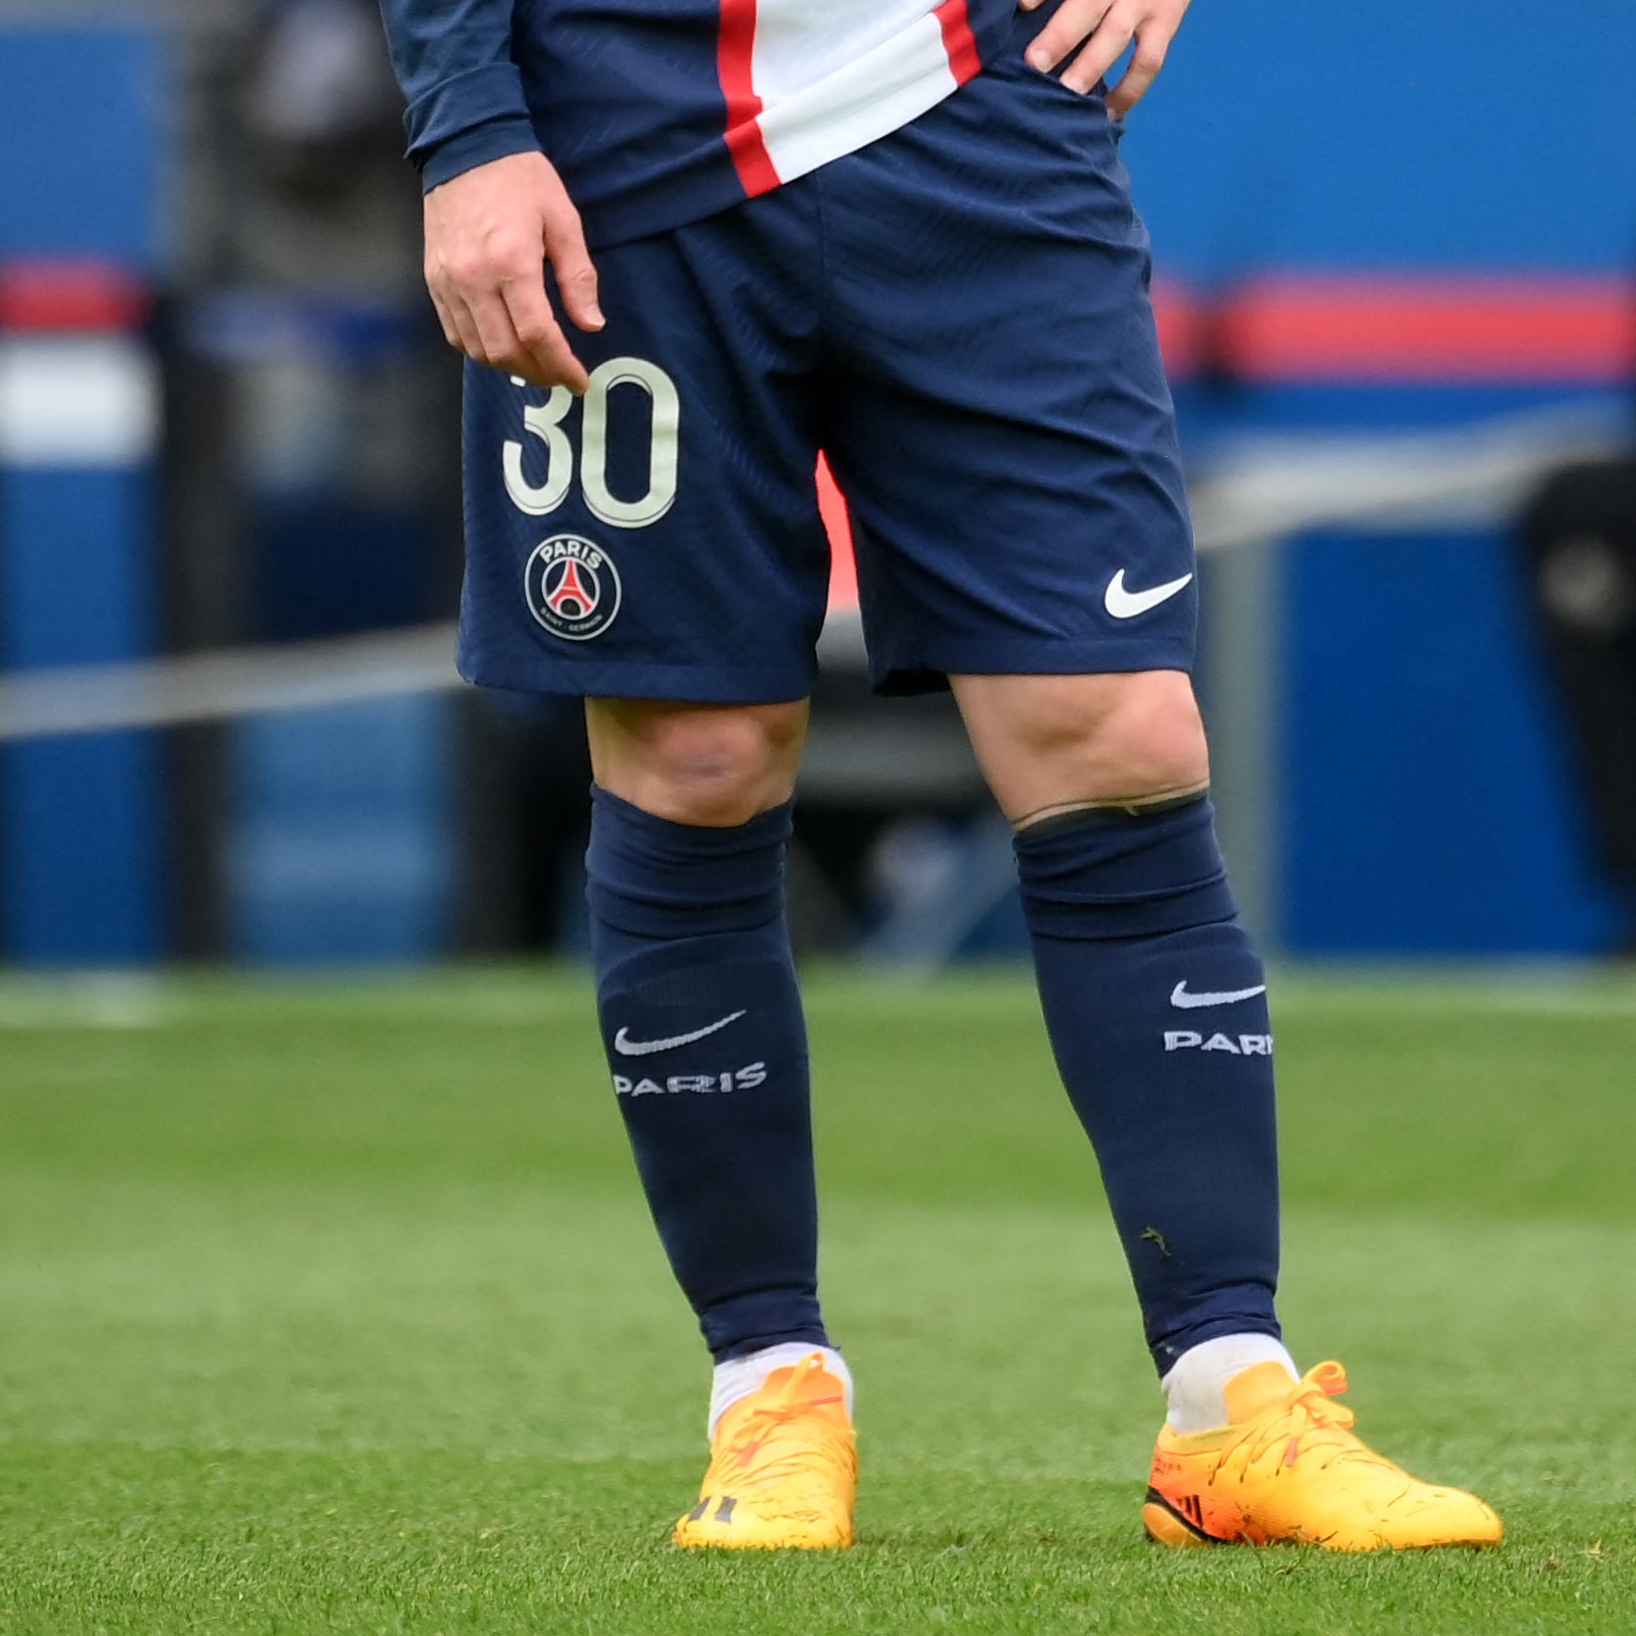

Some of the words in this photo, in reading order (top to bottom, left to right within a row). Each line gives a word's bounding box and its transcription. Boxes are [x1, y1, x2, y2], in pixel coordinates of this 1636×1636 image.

[502, 356, 680, 529] 30
[539, 540, 603, 570] PARIS
[614, 1062, 767, 1097] PARIS
